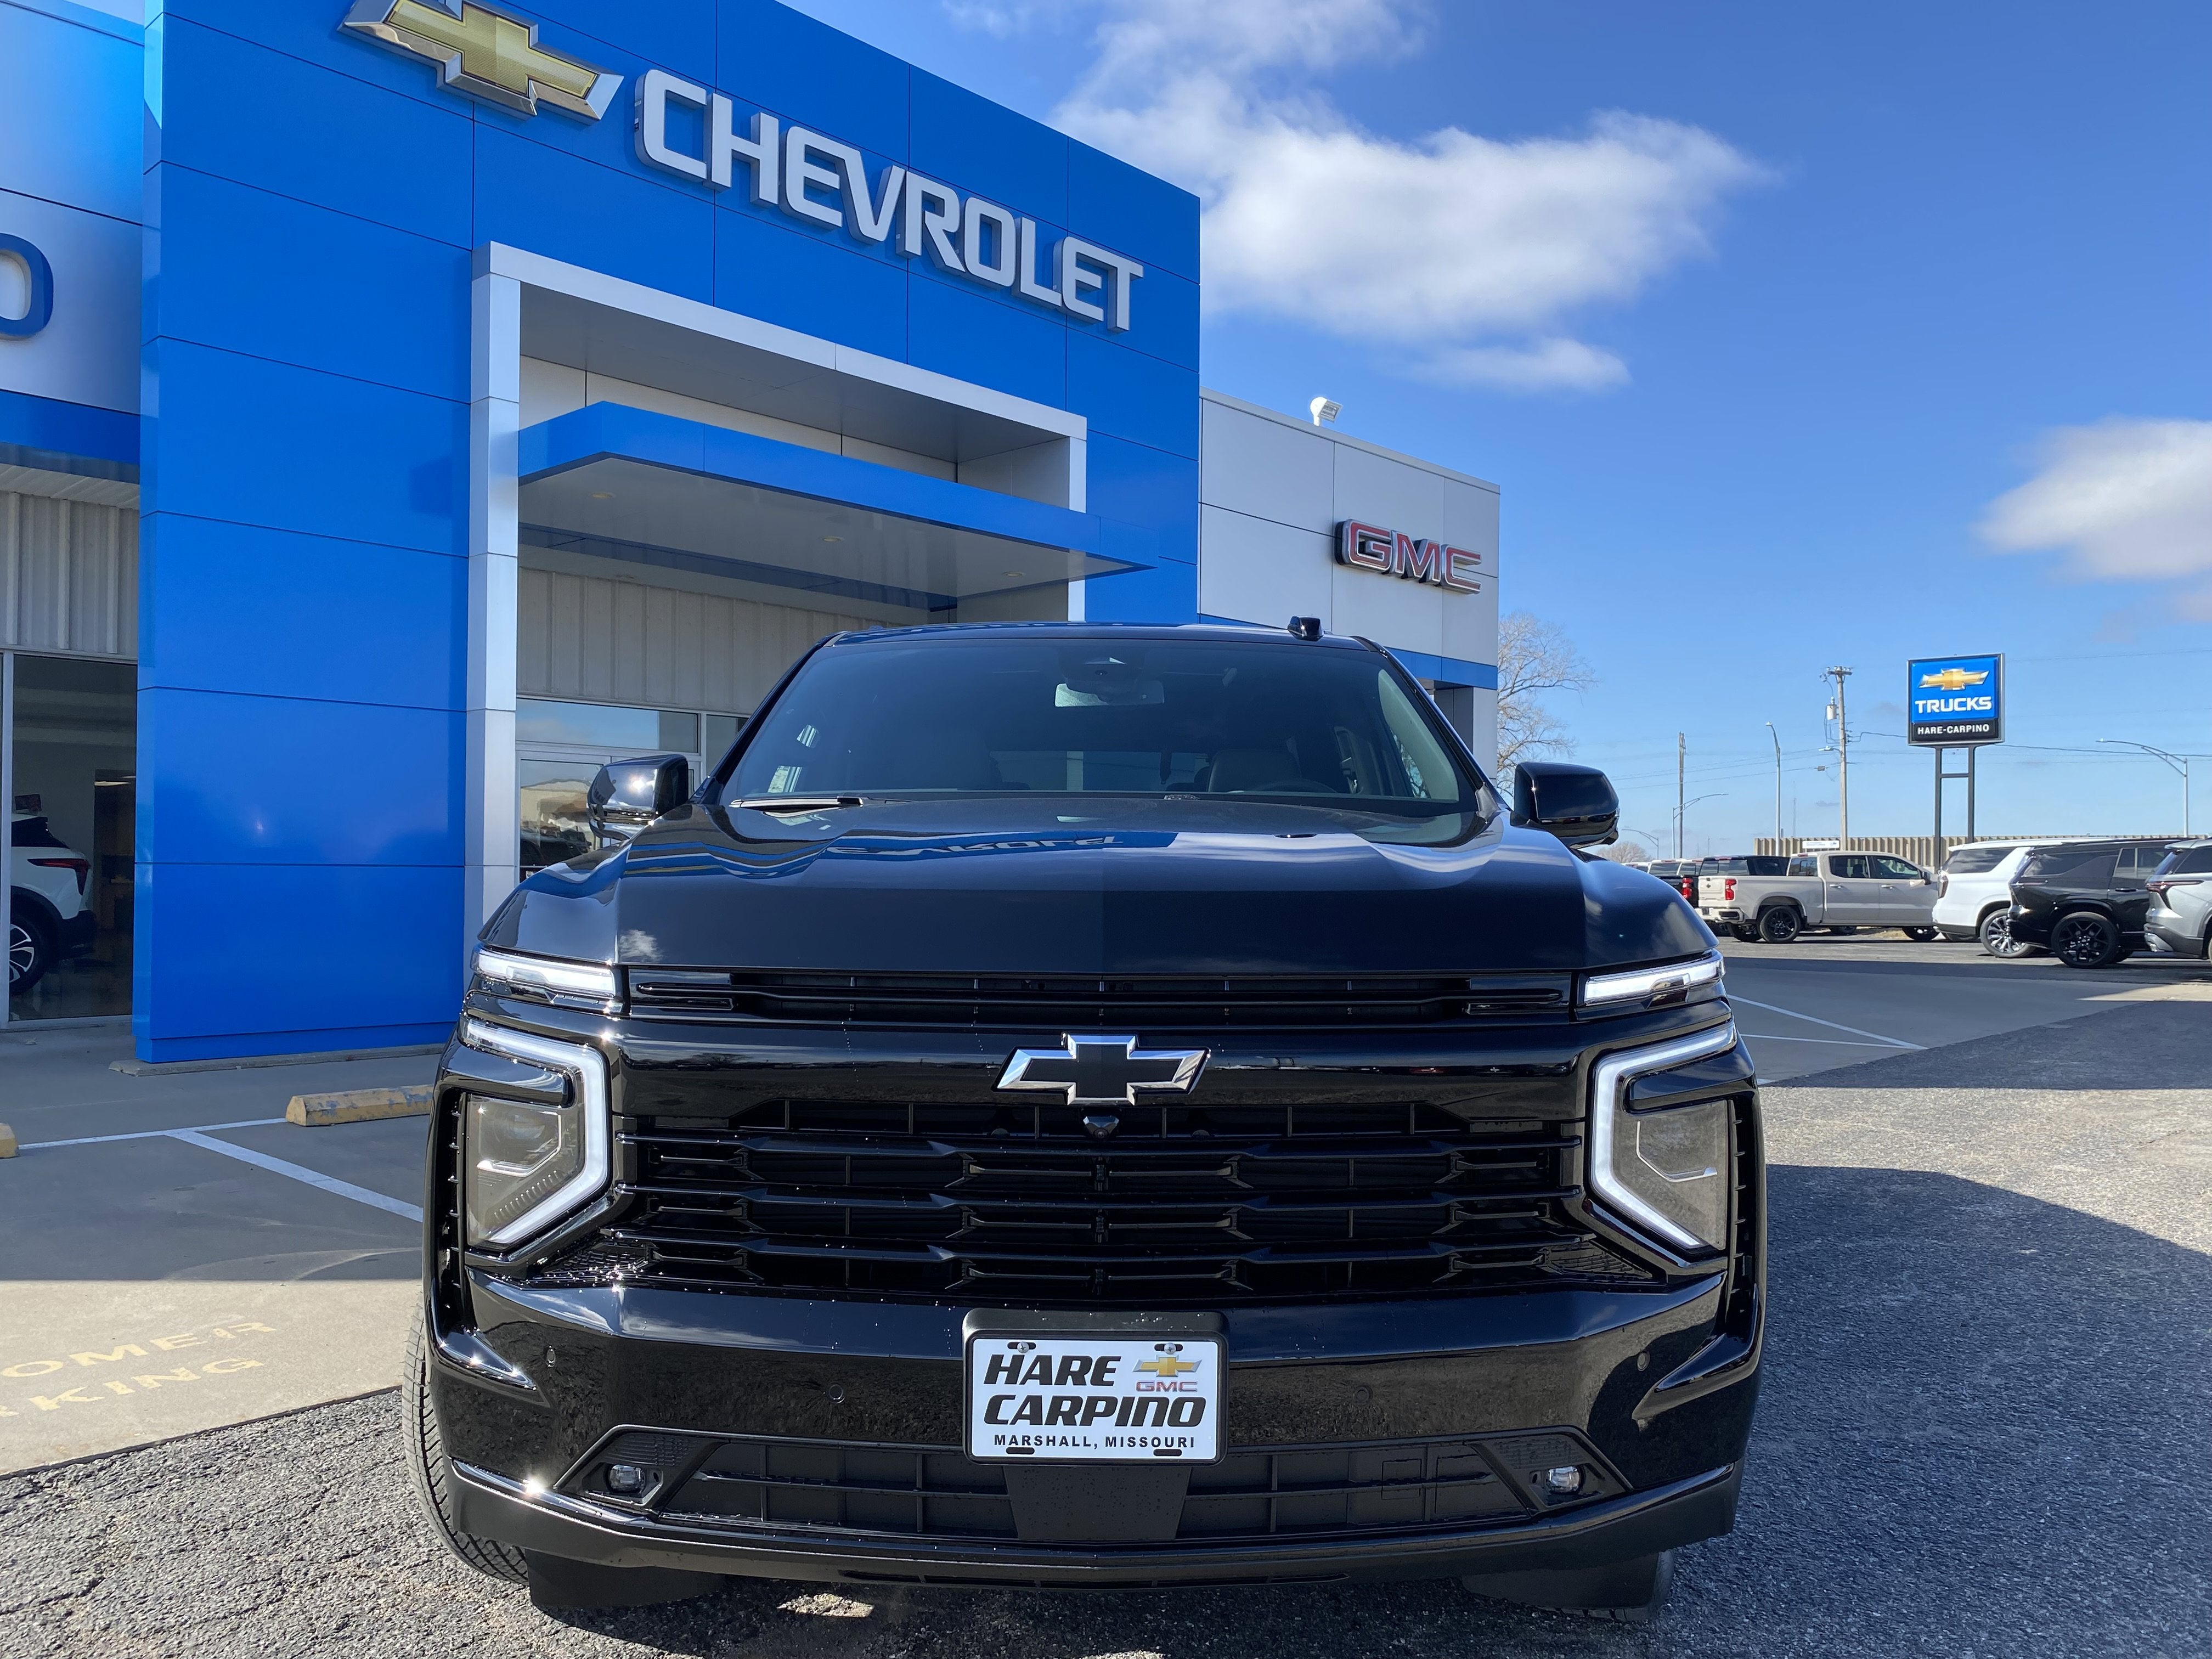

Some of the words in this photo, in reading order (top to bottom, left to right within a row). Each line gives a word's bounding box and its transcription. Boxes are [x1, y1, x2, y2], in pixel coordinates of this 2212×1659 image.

[634, 69, 1143, 331] CHEVROLET
[1335, 519, 1481, 594] GMC
[1914, 696, 1993, 714] TRUCKS
[1917, 724, 1990, 735] HARE-CARPINO
[983, 1353, 1122, 1387] HARE
[1135, 1380, 1199, 1393] GMC
[983, 1394, 1206, 1427] CARPINO
[994, 1434, 1098, 1449] MARSHALL,
[1104, 1436, 1195, 1448] MISSOURI
